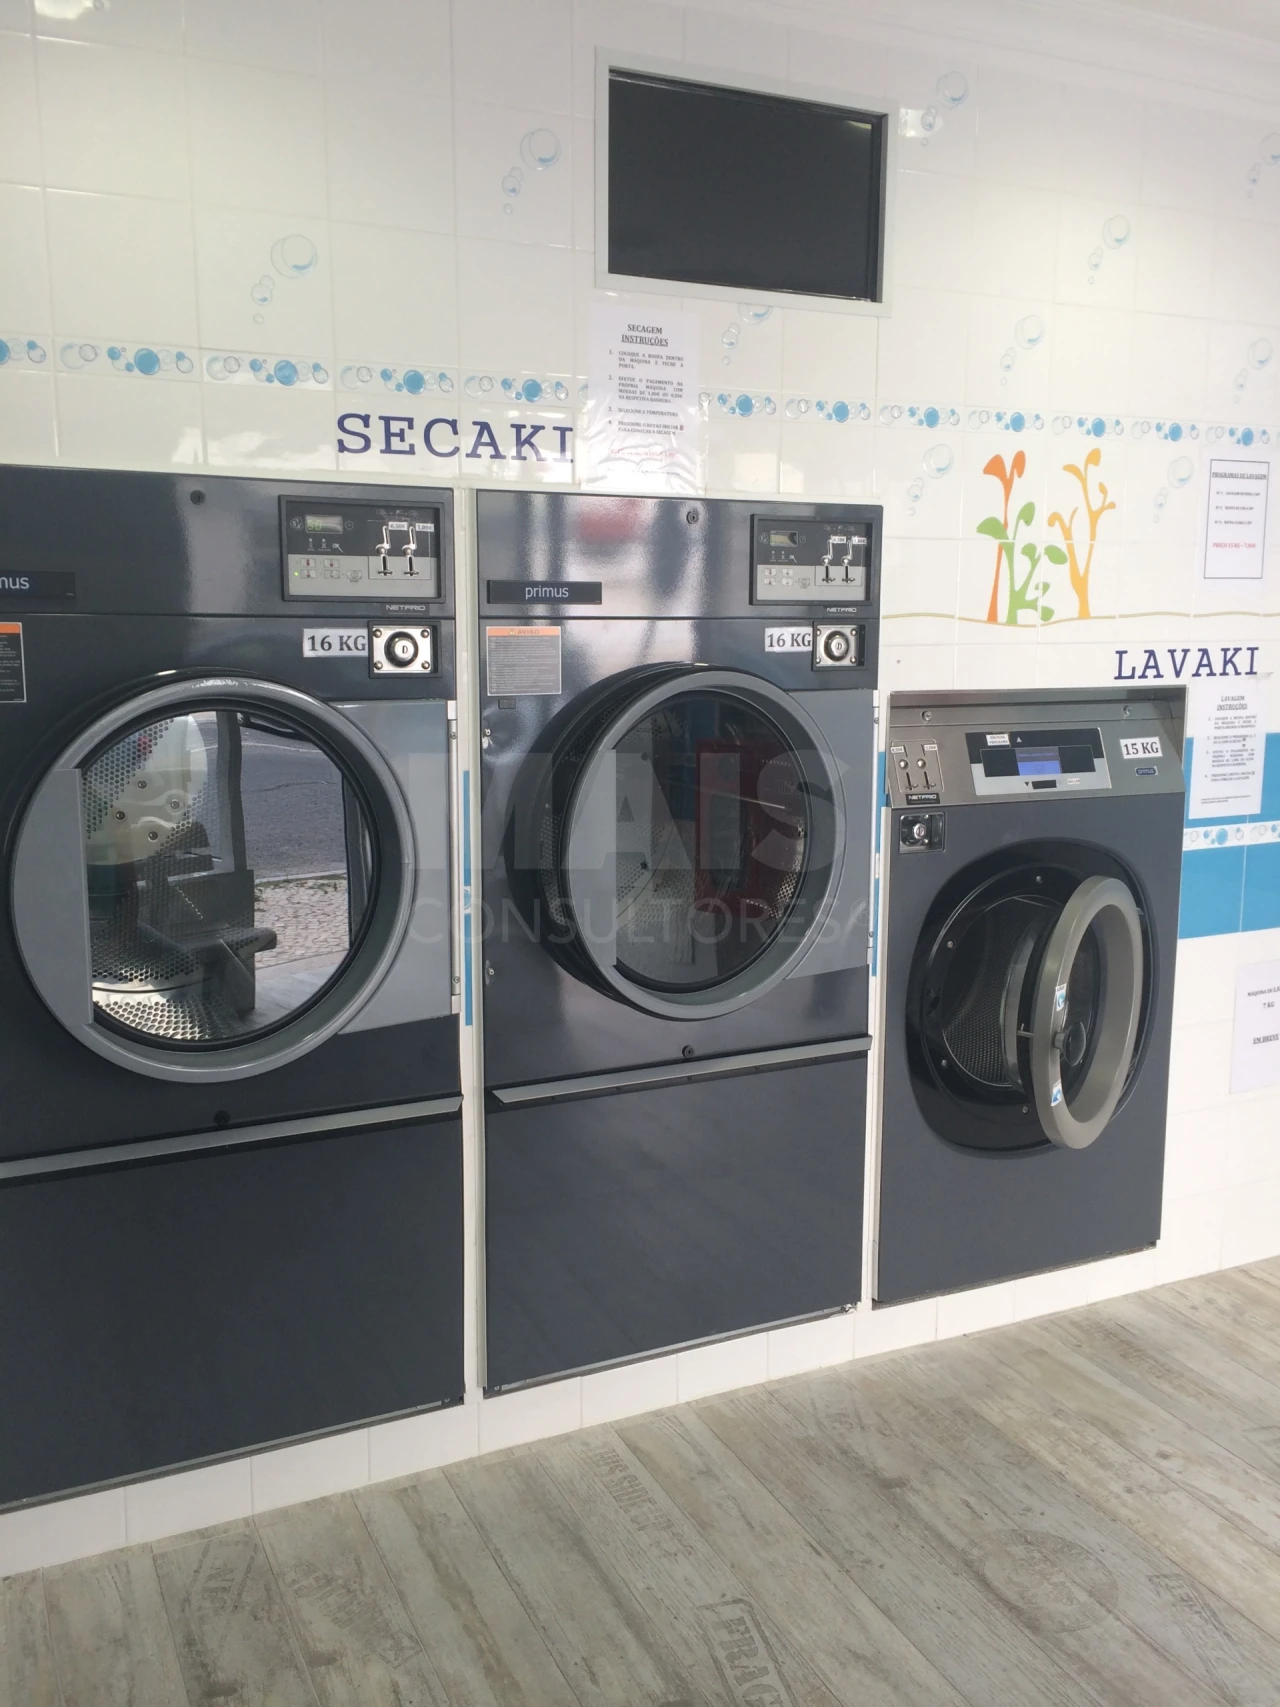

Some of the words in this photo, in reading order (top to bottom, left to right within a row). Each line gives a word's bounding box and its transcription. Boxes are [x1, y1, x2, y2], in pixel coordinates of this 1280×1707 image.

[627, 324, 662, 335] SECAGEM
[621, 334, 668, 347] INSTRUÇÕES
[646, 378, 674, 386] PAGAMENTO
[336, 412, 575, 464] SECAKI
[525, 585, 569, 600] primus
[307, 635, 332, 651] 16
[338, 635, 366, 651] KG
[767, 633, 785, 648] 16
[790, 633, 811, 648] KG
[1113, 646, 1260, 681] LAVAKI
[1216, 703, 1248, 711] INSTRUÇÕES
[1123, 742, 1139, 756] 15
[1141, 740, 1159, 755] KG
